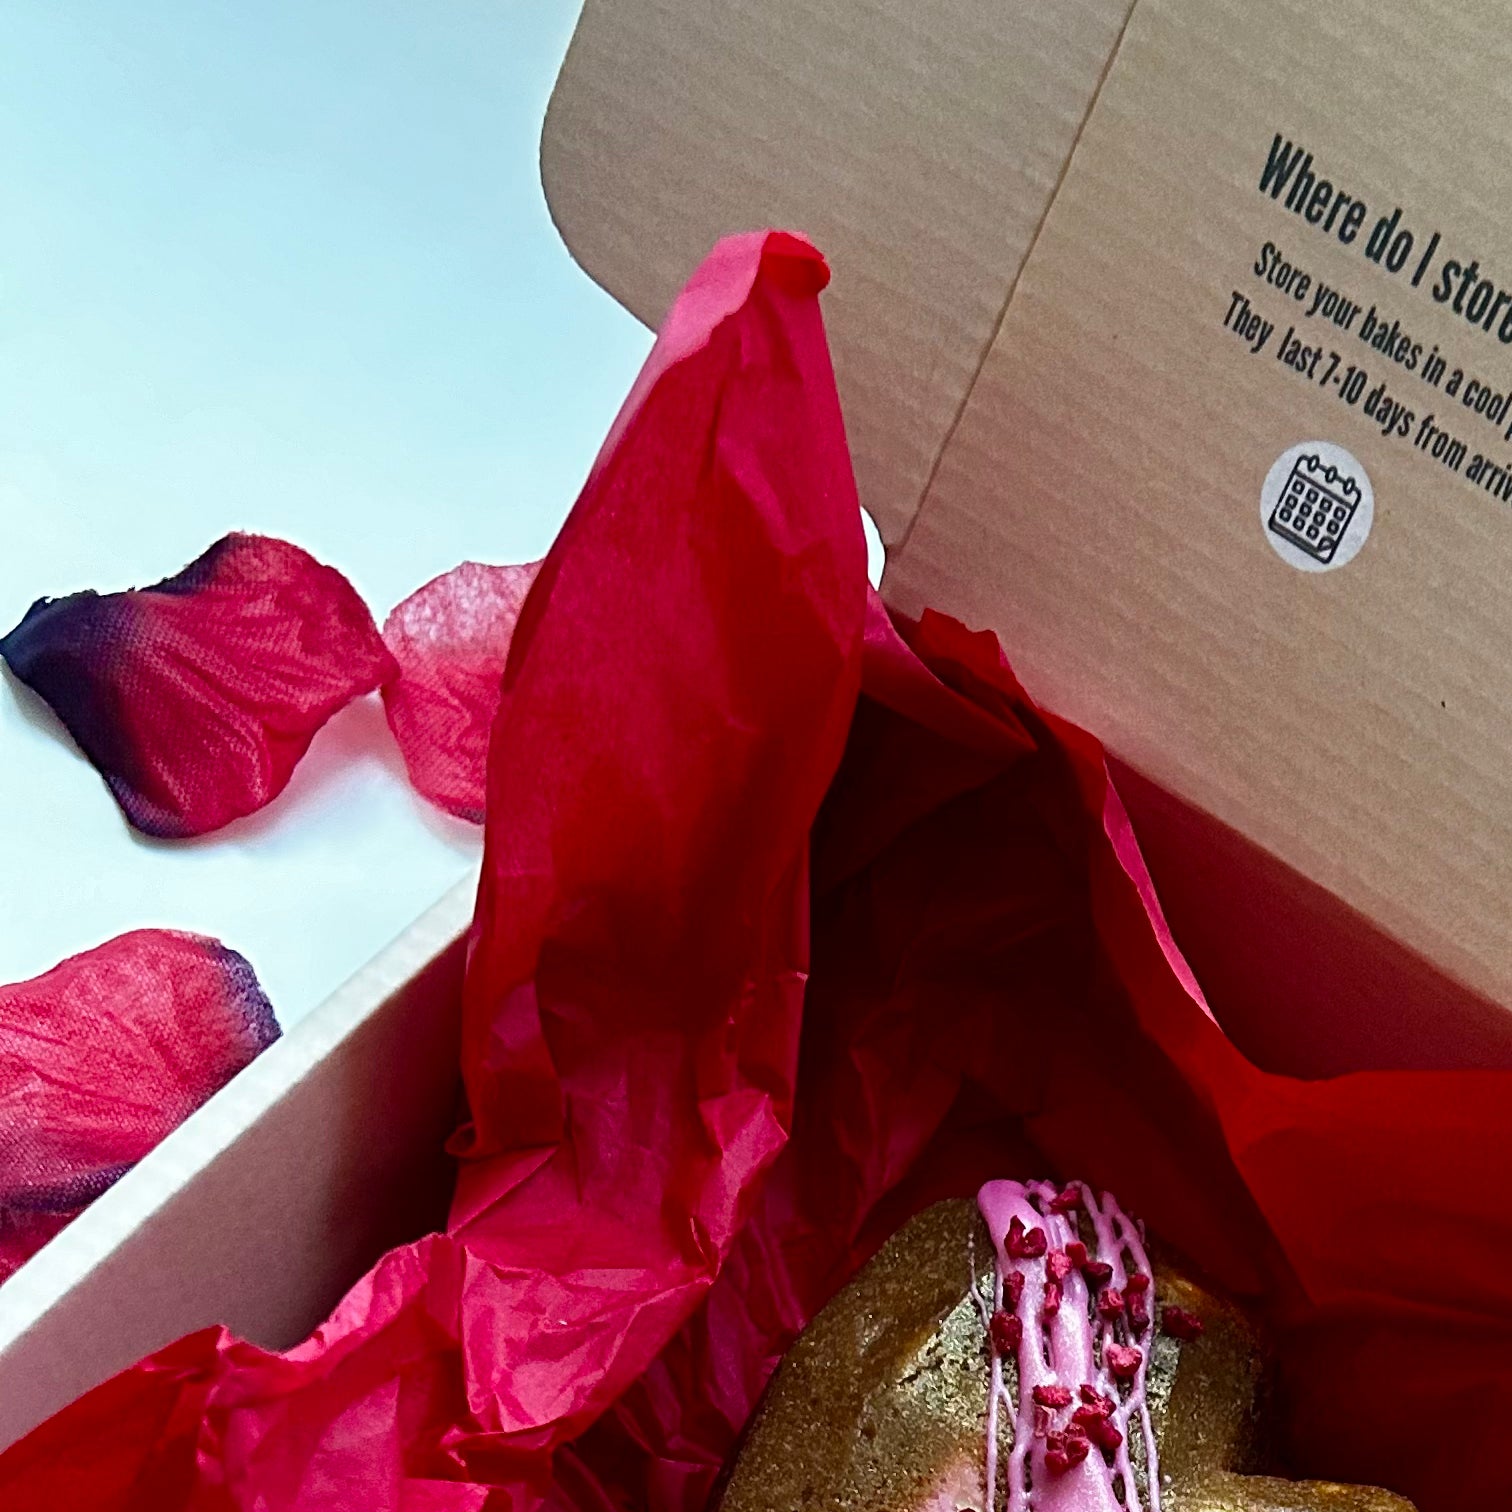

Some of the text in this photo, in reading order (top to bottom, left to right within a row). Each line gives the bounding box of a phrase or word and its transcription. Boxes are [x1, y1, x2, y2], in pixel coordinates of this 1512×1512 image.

[1258, 132, 1367, 245] Where
[1364, 207, 1414, 274] do
[1410, 231, 1442, 288] I
[1223, 290, 1275, 354] They
[1276, 326, 1323, 380] last
[1319, 351, 1368, 406] 7-10
[1363, 383, 1416, 438] days
[1413, 414, 1468, 472] from
[1253, 241, 1312, 302] Store
[1304, 282, 1362, 331] your
[1358, 305, 1423, 371] bakes
[1420, 344, 1447, 388] in
[1445, 368, 1464, 398] a
